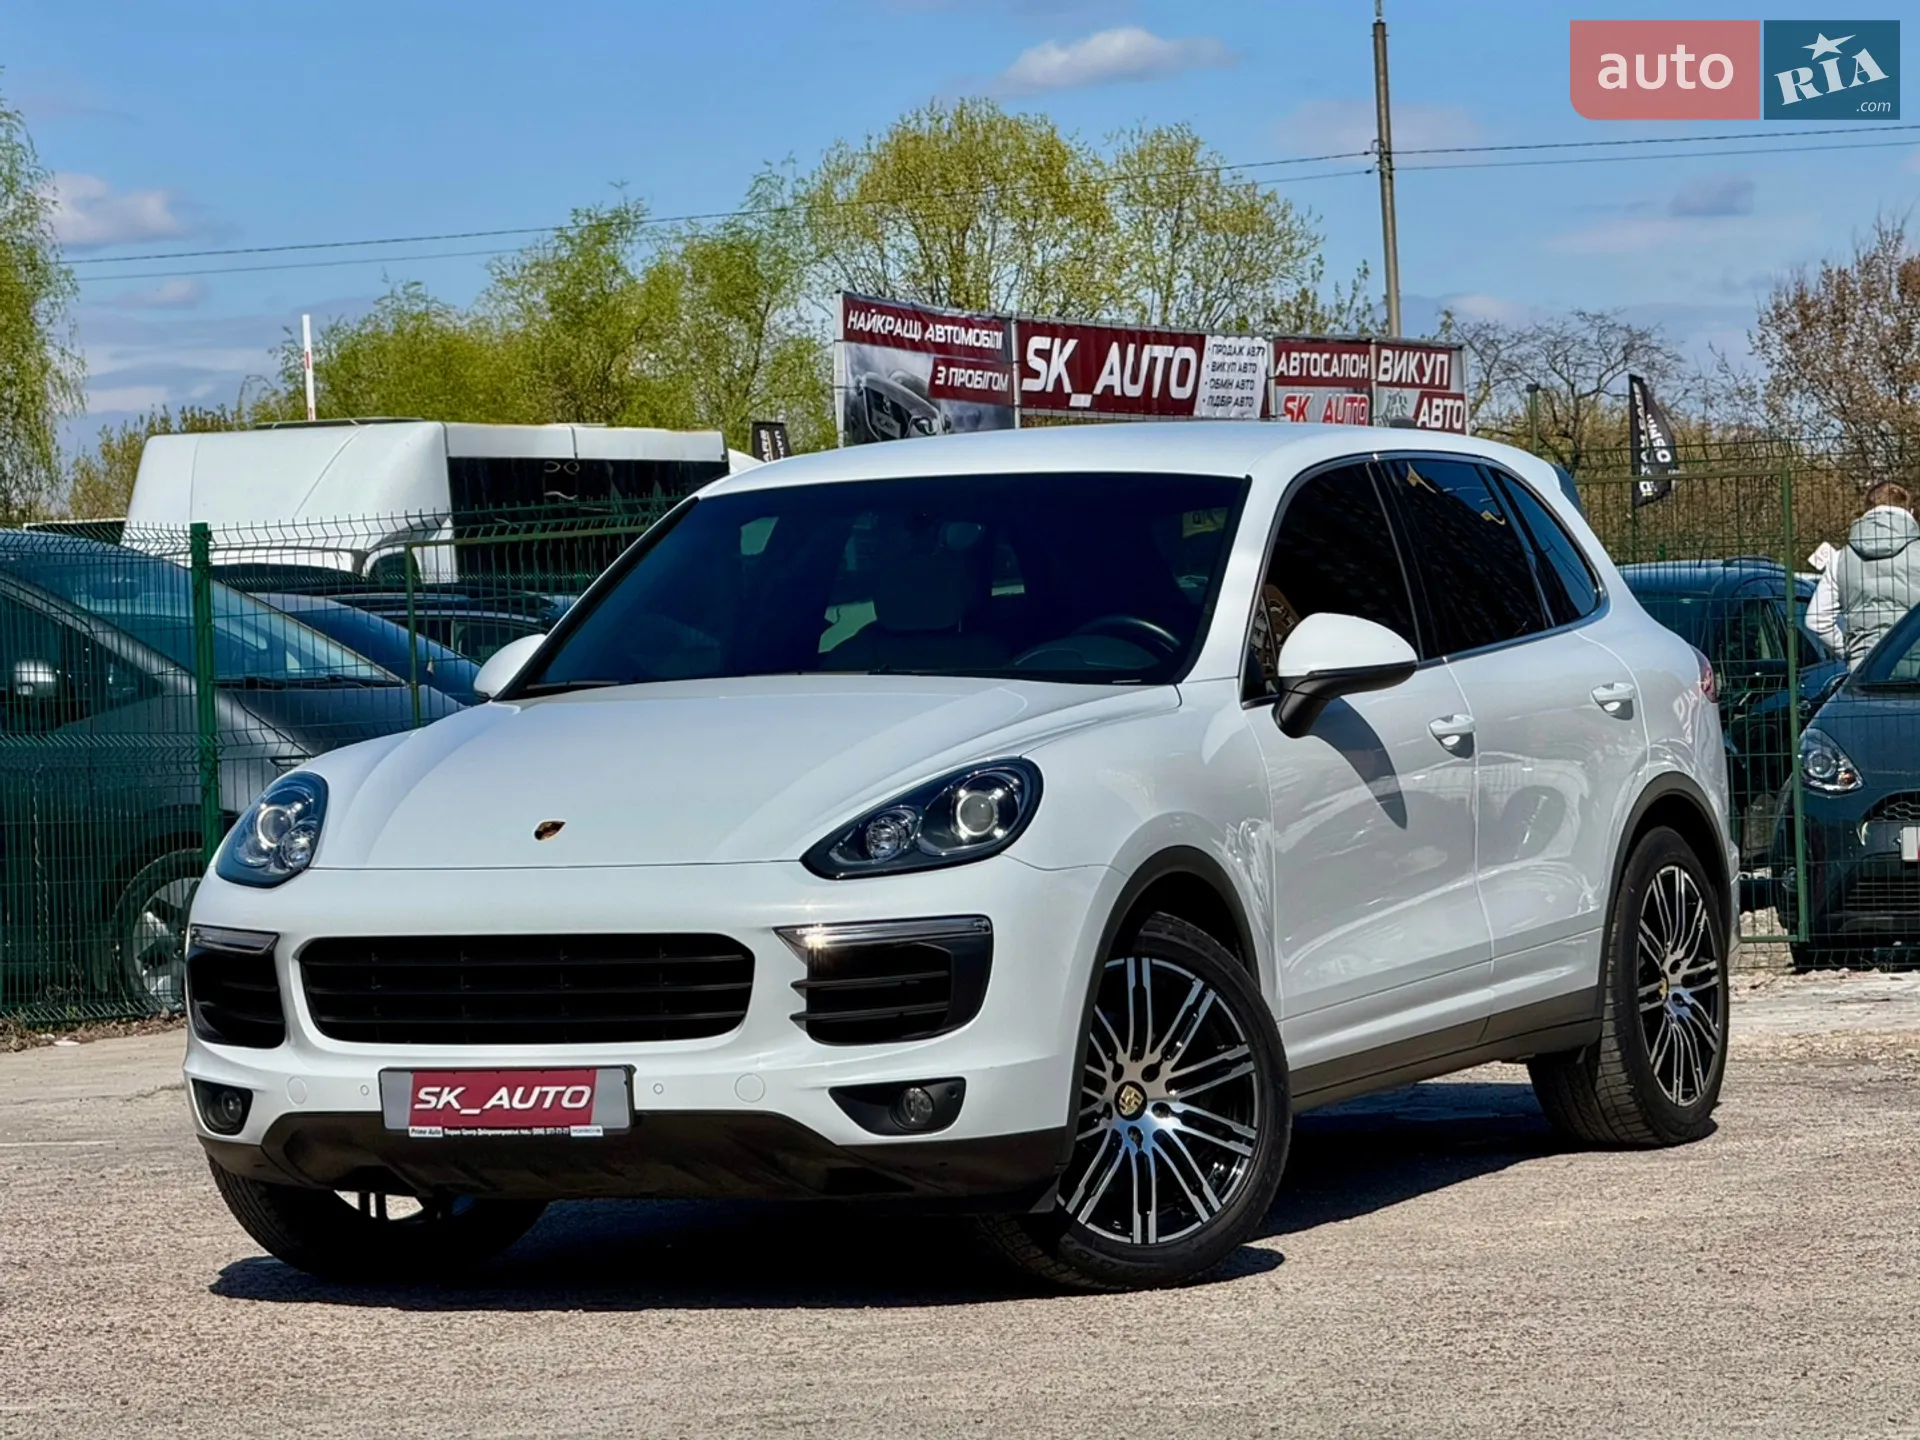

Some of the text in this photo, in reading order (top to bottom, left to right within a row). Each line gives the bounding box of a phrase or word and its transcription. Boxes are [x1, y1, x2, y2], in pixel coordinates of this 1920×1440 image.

[924, 322, 1003, 351] АВТОМОБІЛІ
[1021, 336, 1198, 408] SK_AUTO
[1210, 361, 1258, 374] ВИКУП АВТО
[1275, 351, 1370, 379] АВТОСАЛОН
[1377, 349, 1449, 387] ВИКУП
[934, 366, 1009, 393] З ПРОБІГОМ
[1235, 379, 1255, 391] АВТО
[1233, 395, 1255, 408] АВТО
[1416, 397, 1464, 430] АВТО
[413, 1085, 592, 1115] SK_AUTO
